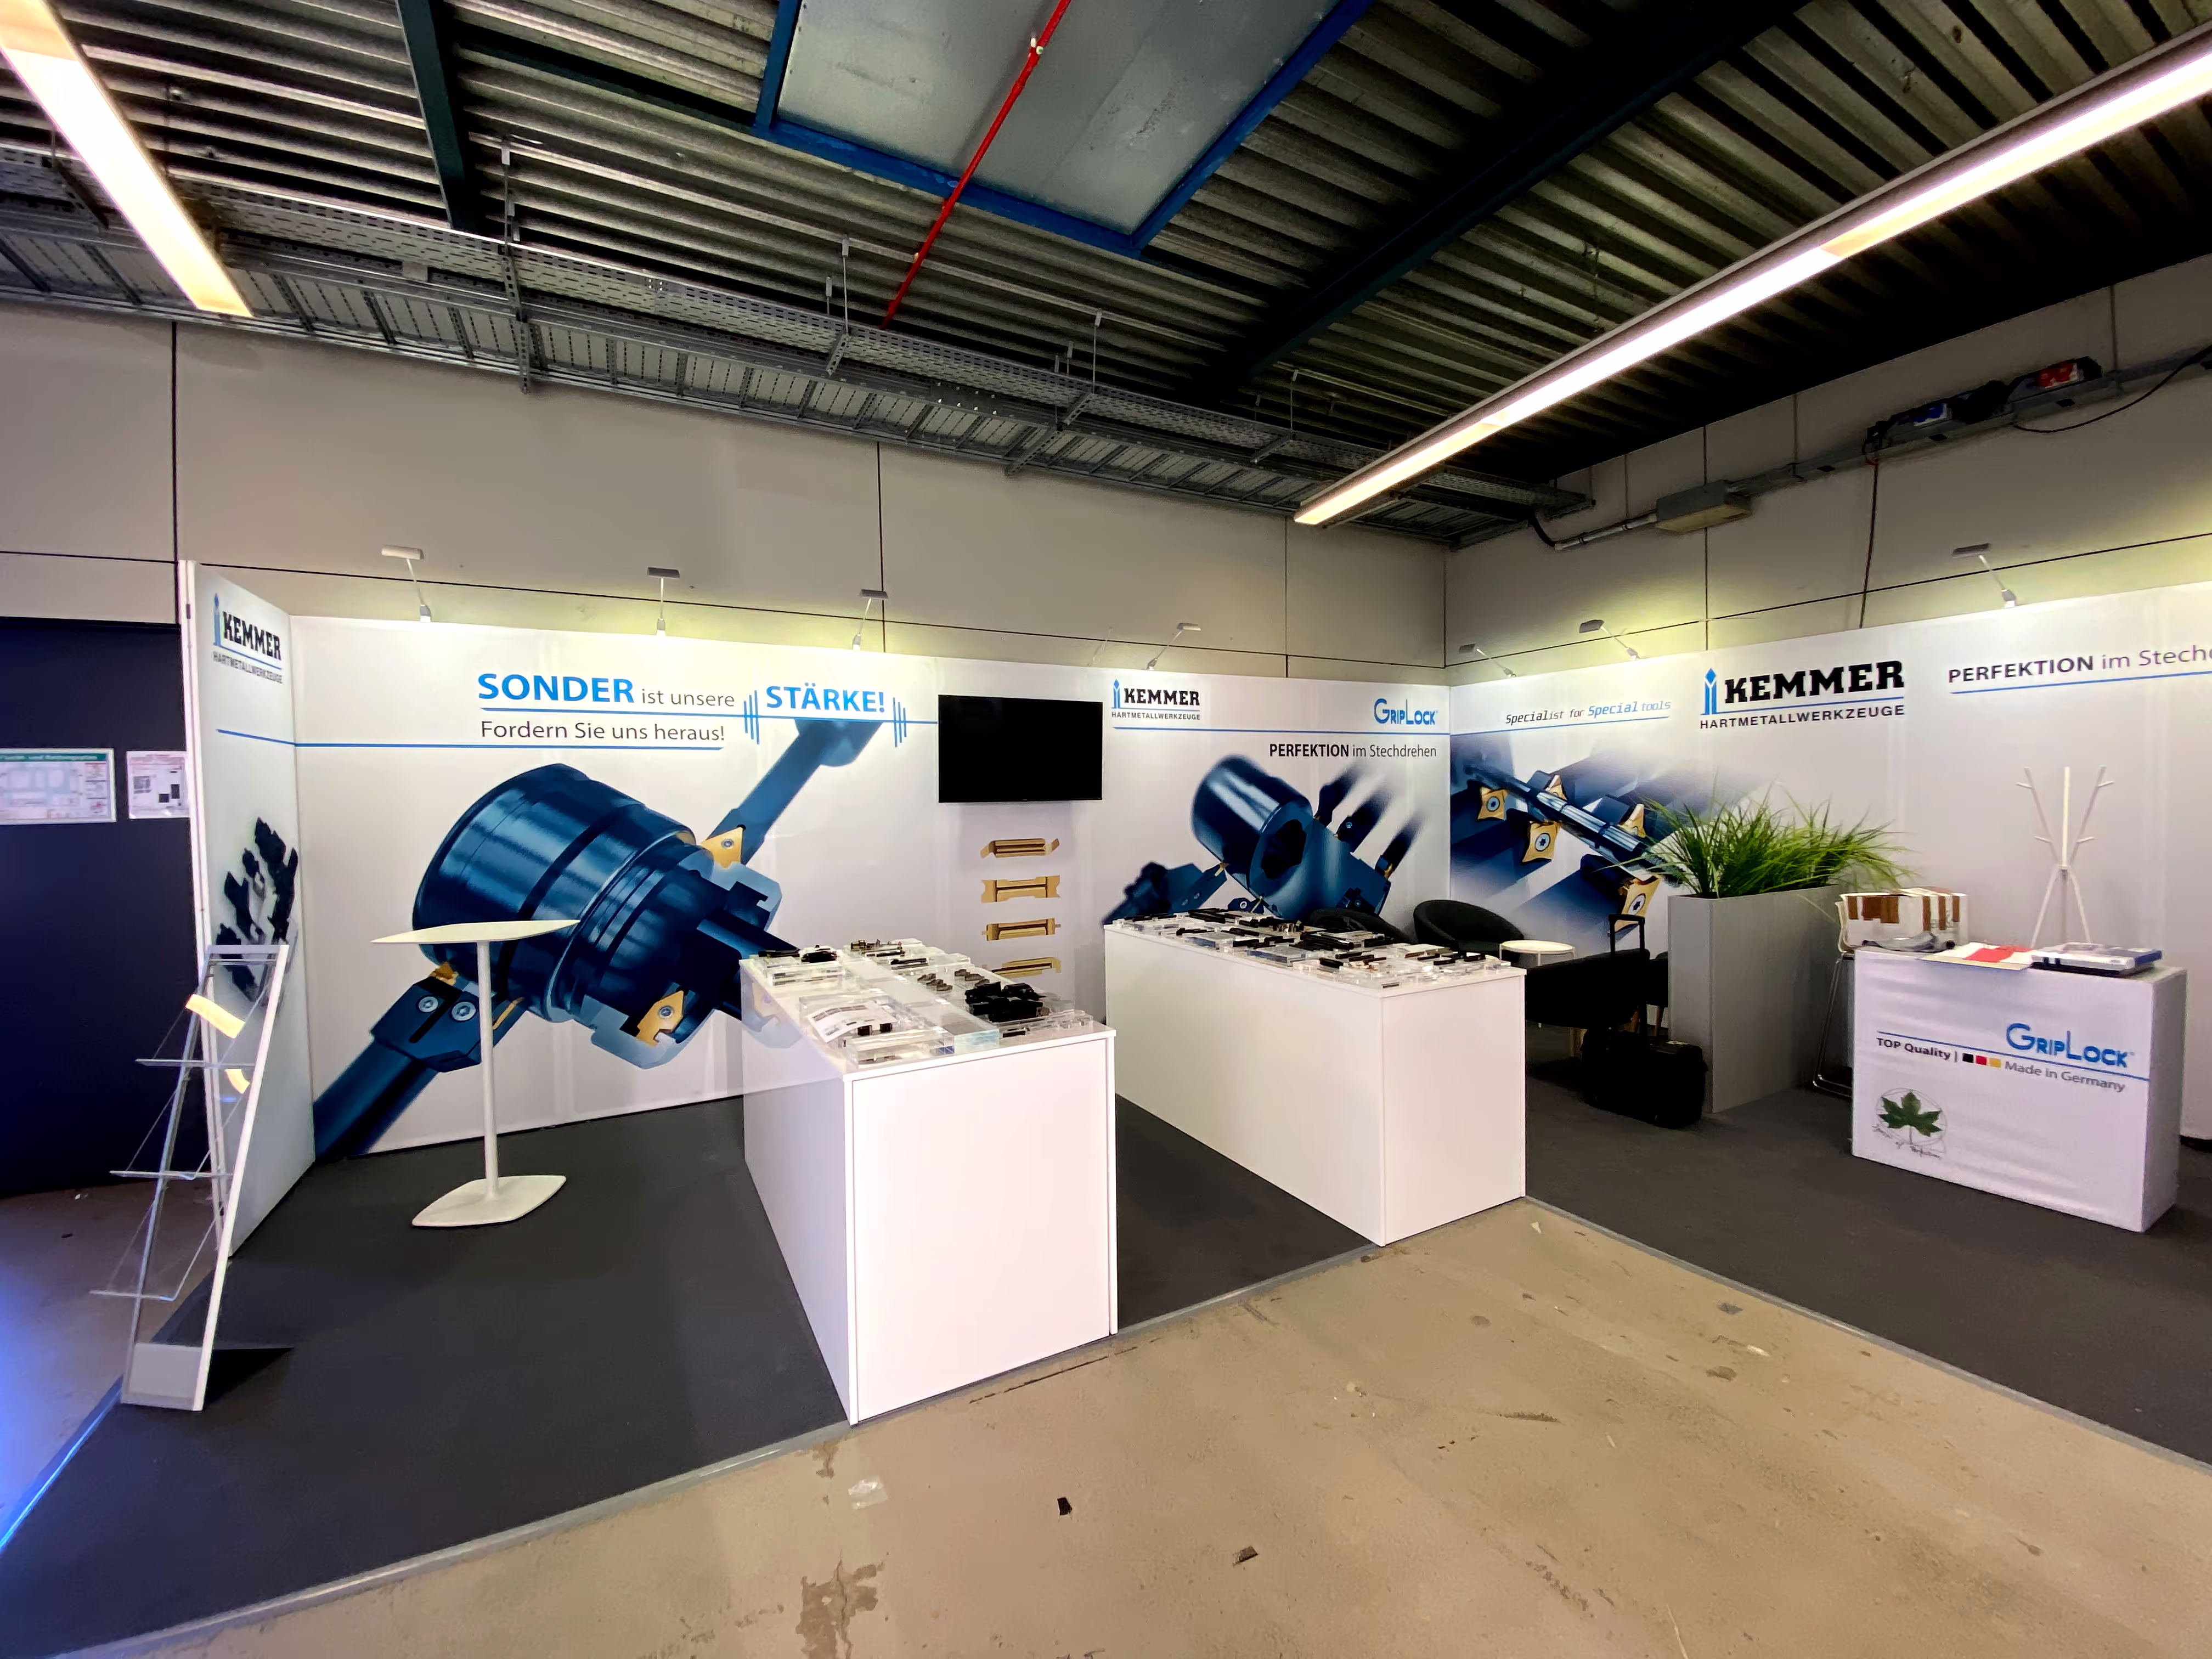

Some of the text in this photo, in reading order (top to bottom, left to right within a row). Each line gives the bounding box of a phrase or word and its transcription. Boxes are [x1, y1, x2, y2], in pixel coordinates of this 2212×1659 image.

[222, 611, 281, 661] KEMMER
[1948, 656, 2093, 683] PERFEKTION
[2102, 654, 2130, 669] im
[478, 673, 885, 713] SONDER ist unsere STÄRKE!
[1724, 660, 1905, 704] KEMMER
[1124, 688, 1200, 706] KEMMER
[1111, 712, 1201, 720] HARTMETALLWERKZEUGE
[1505, 700, 1671, 725] Specialist for Special tools
[1700, 704, 1905, 730] HARTMETALLWERKZEUGE
[481, 721, 725, 741] Fordern Sie uns heraus!
[1269, 743, 1437, 757] PERFEKTION im Stechdrehen
[1876, 1037, 1951, 1063] TOP Quality
[2004, 1061, 2125, 1093] Made in Germany
